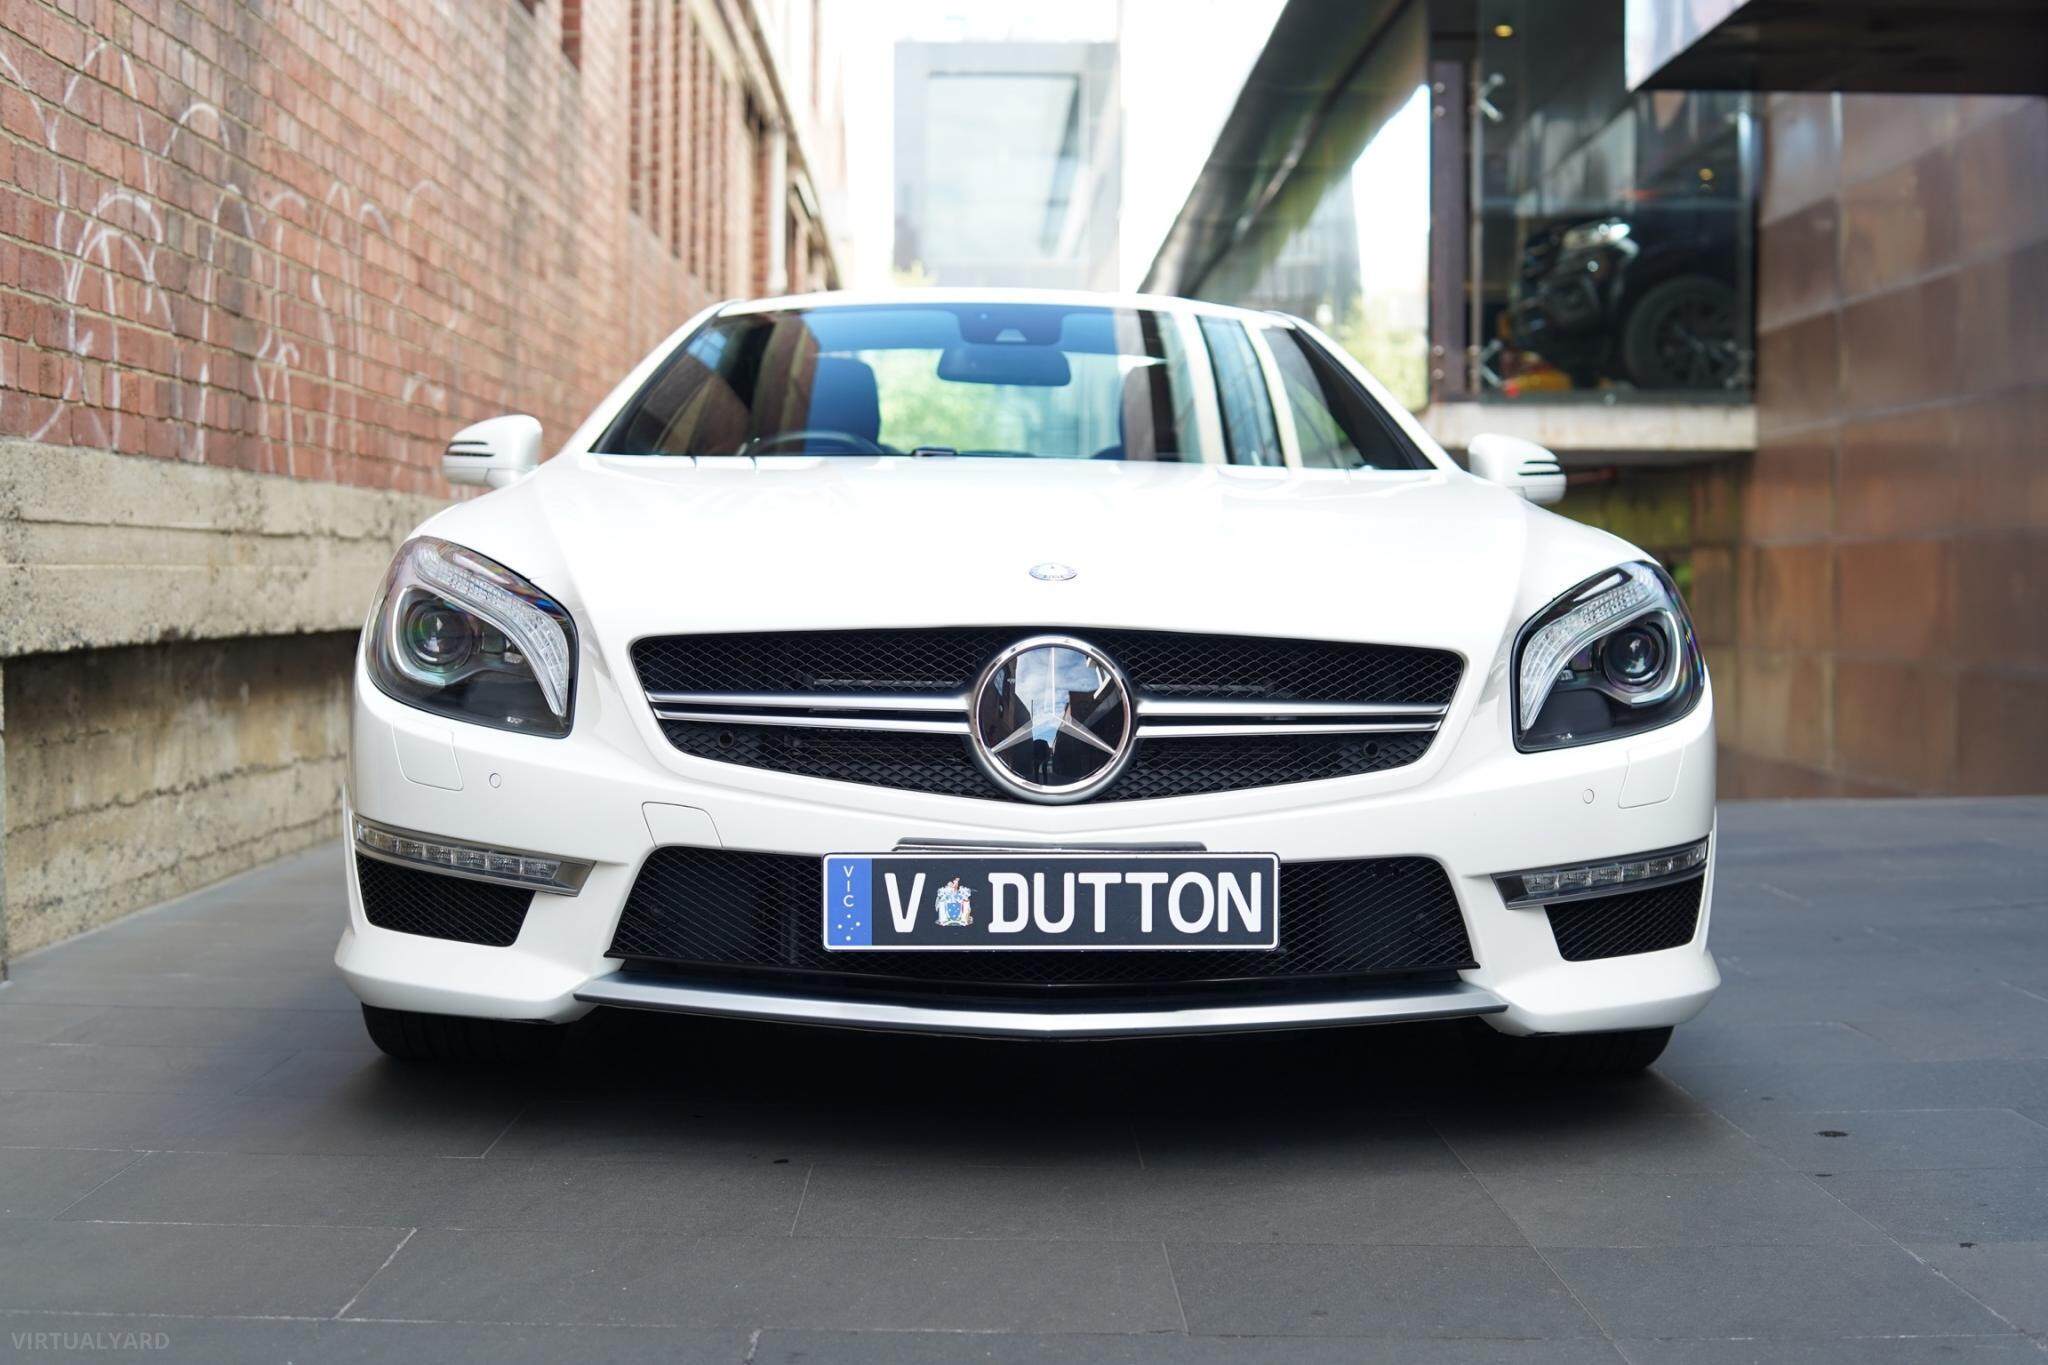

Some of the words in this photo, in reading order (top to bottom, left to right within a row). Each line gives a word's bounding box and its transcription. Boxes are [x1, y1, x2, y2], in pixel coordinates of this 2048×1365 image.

[843, 865, 854, 908] VIC
[884, 872, 926, 933] V
[987, 871, 1262, 934] DUTTON
